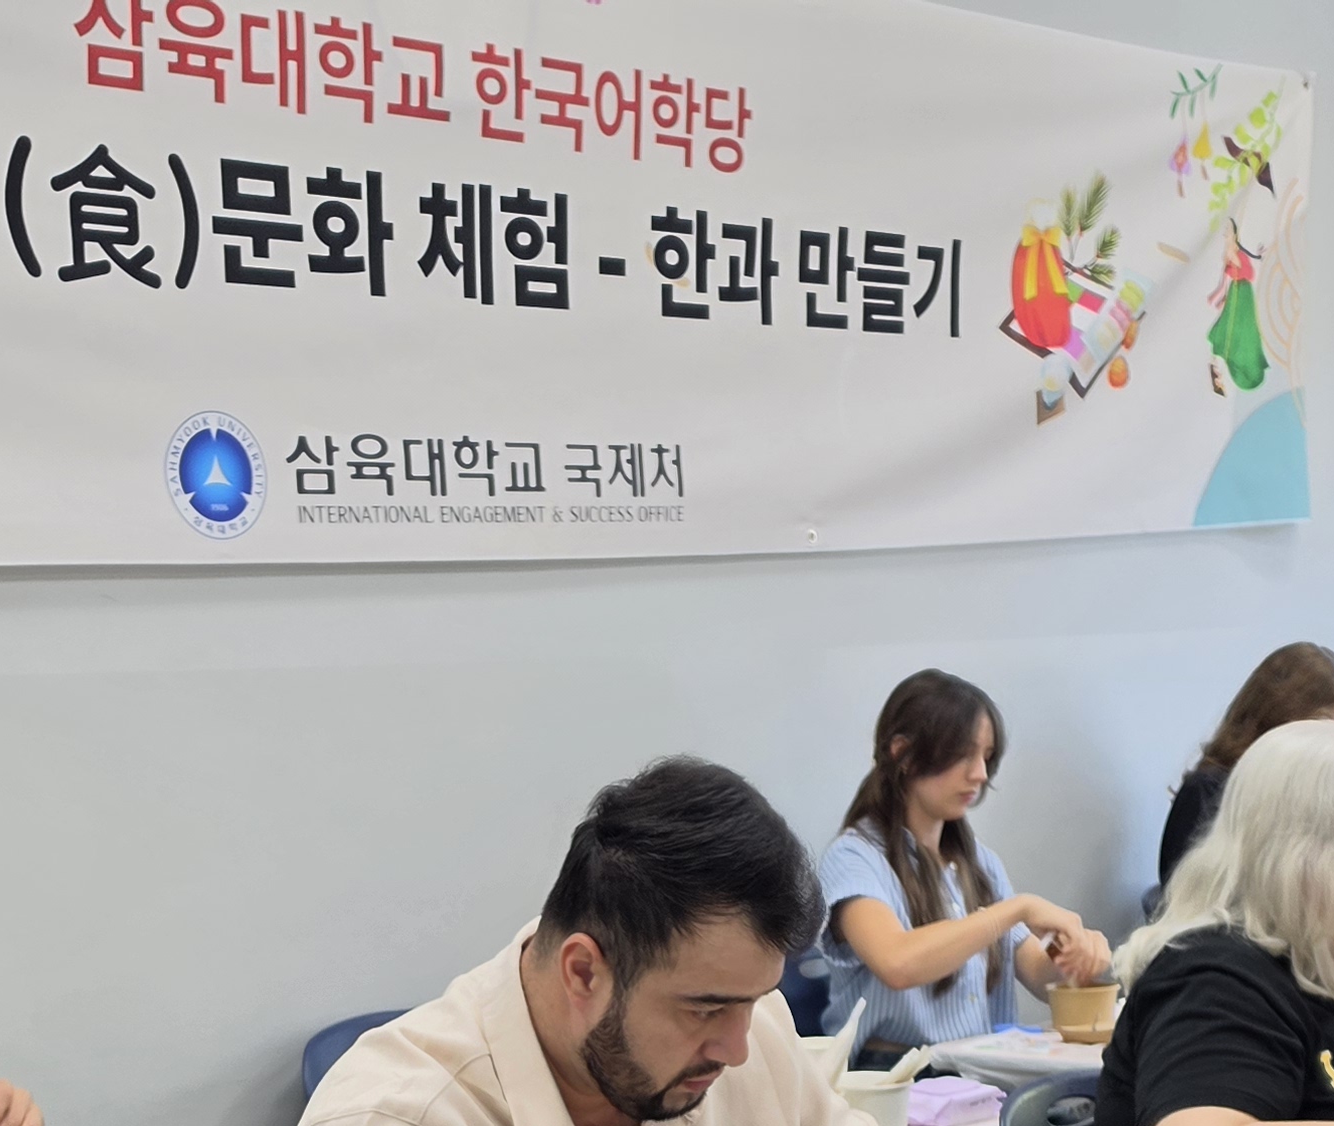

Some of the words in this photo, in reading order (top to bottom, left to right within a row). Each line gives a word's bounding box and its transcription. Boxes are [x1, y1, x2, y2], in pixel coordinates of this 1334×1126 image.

[74, 0, 451, 124] 삼육대학교
[470, 42, 752, 174] 한국어학당
[419, 182, 571, 310] 체험
[599, 256, 626, 276] -
[651, 206, 778, 325] 한과
[798, 226, 962, 338] 만들기
[286, 433, 546, 497] 삼육대학교
[564, 442, 685, 499] 국제처
[297, 504, 435, 525] INTERNATIONAL
[440, 504, 546, 524] ENGAGEMENT
[551, 508, 564, 522] &
[569, 505, 635, 523] SUCCESS
[638, 505, 686, 522] OFFICE
